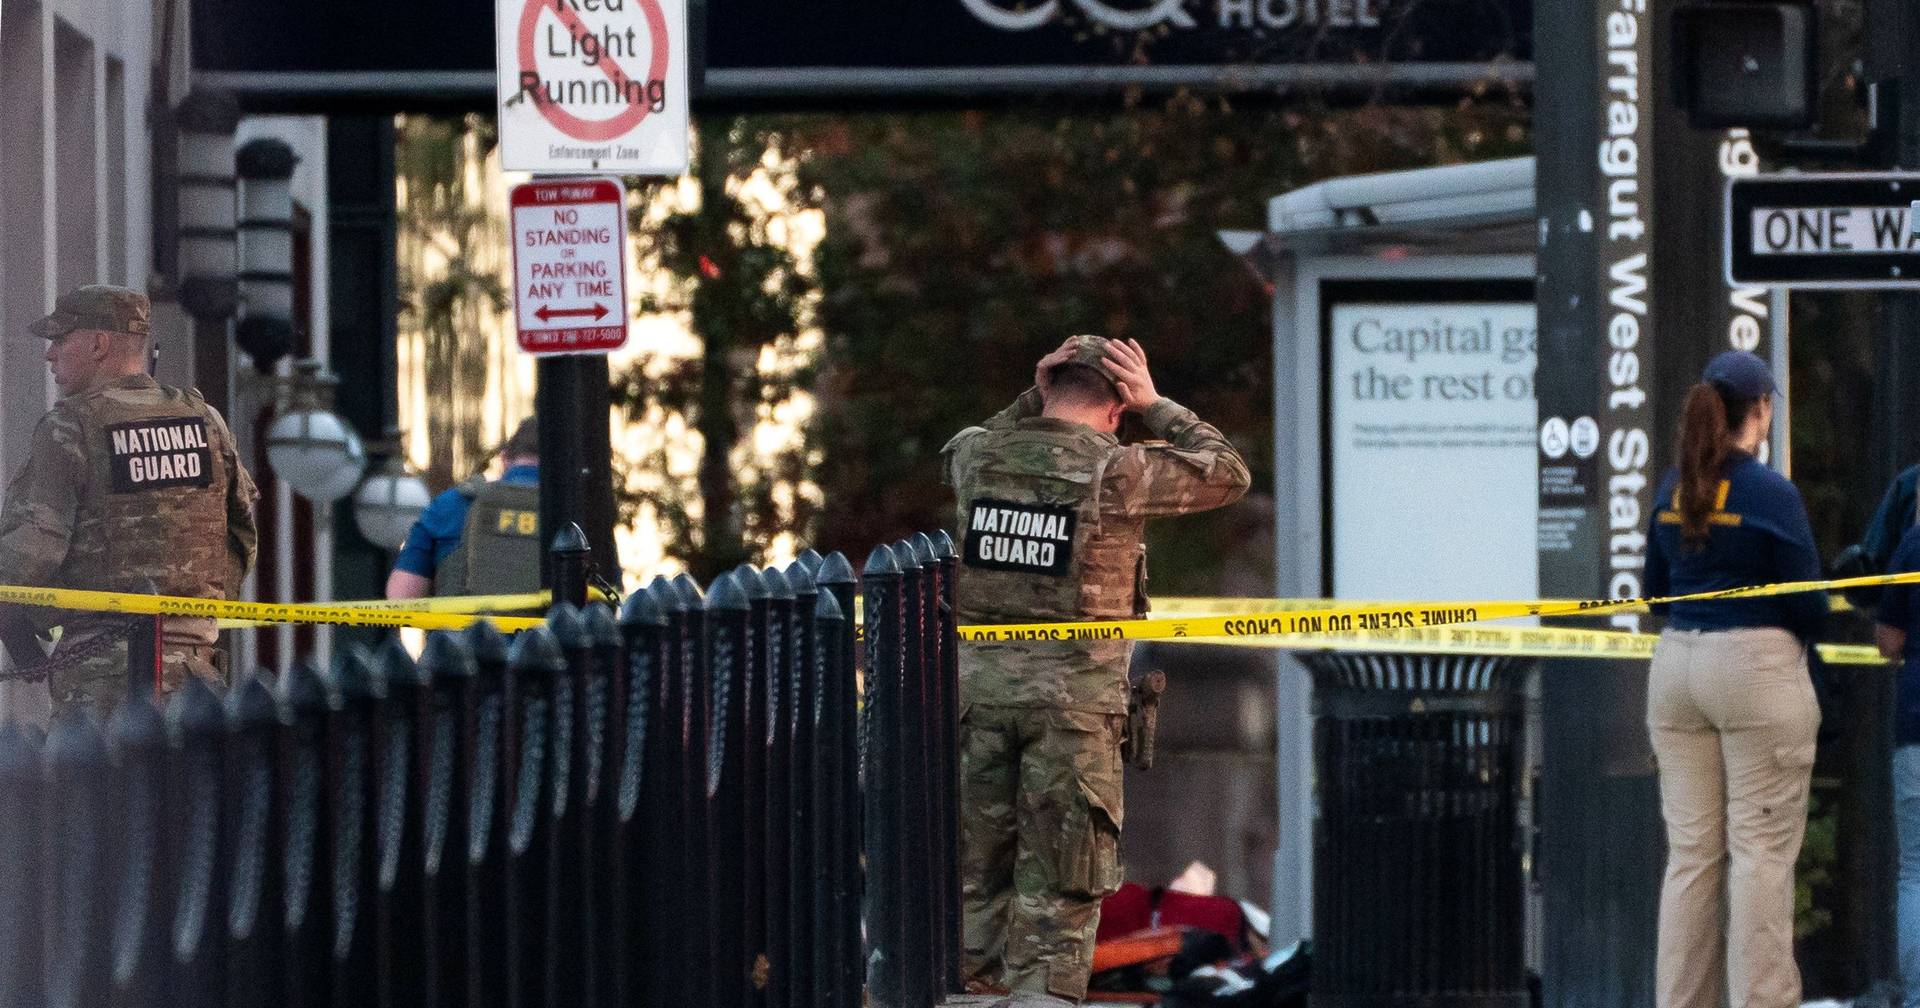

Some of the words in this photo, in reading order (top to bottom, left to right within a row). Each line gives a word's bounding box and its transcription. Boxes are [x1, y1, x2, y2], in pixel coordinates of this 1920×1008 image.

[548, 24, 636, 66] Light
[519, 71, 665, 113] Running
[554, 209, 579, 225] NO
[1765, 209, 1852, 250] ONE
[526, 228, 610, 247] STANDING
[531, 260, 607, 279] PARKING
[528, 282, 564, 299] ANY
[575, 280, 613, 297] TIME
[1352, 318, 1492, 363] Capital
[1608, 253, 1648, 410] West
[1352, 367, 1413, 401] the
[1422, 369, 1495, 401] rest
[112, 424, 208, 455] NATIONAL
[129, 452, 201, 483] GUARD
[971, 506, 1070, 541] NATIONAL
[979, 535, 1056, 567] GUARD
[1224, 617, 1282, 636] CROSS
[1358, 610, 1415, 630] SCENE
[1420, 607, 1478, 626] CRIME
